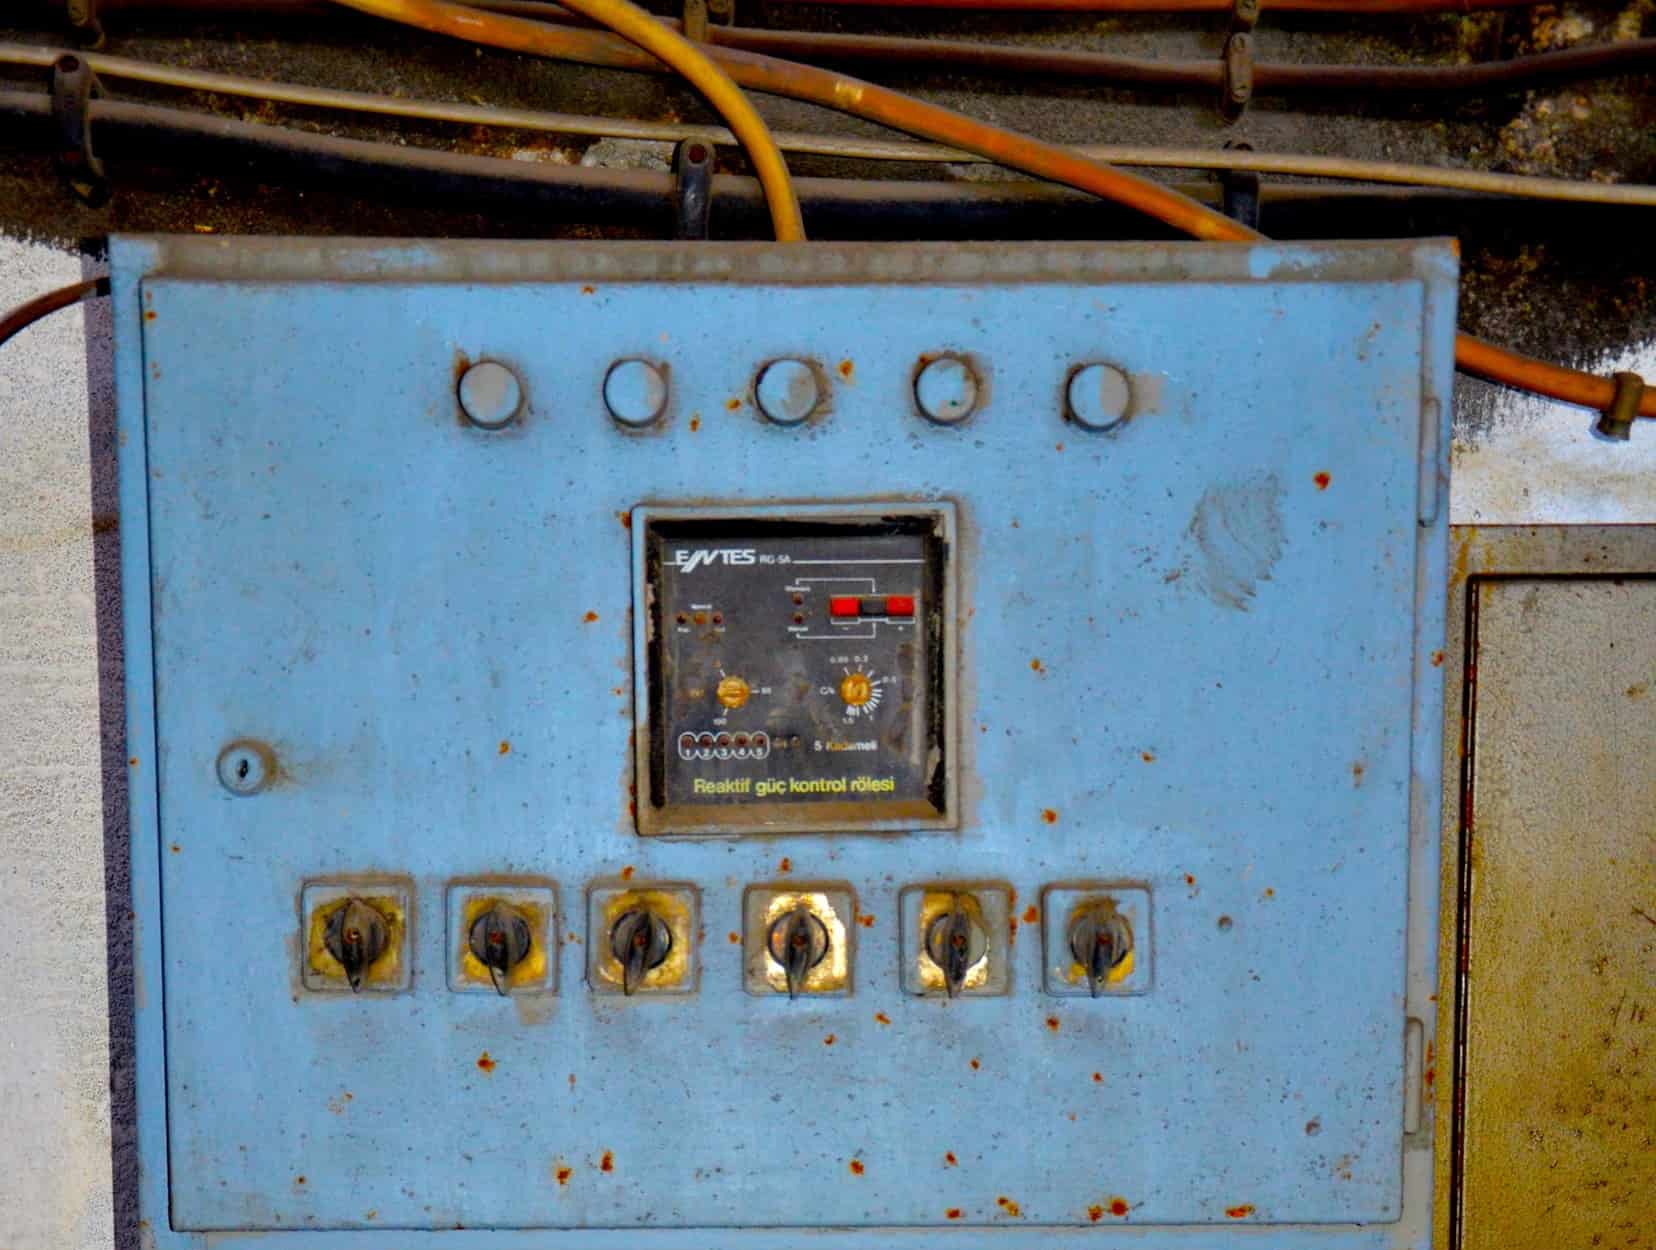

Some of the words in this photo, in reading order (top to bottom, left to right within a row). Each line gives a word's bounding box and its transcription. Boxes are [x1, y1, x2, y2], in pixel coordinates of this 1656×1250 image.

[675, 549, 756, 573] ENTES
[693, 778, 751, 794] Reaktif
[755, 779, 787, 797] güç
[789, 776, 847, 793] kontrol
[850, 776, 895, 792] rölesi
